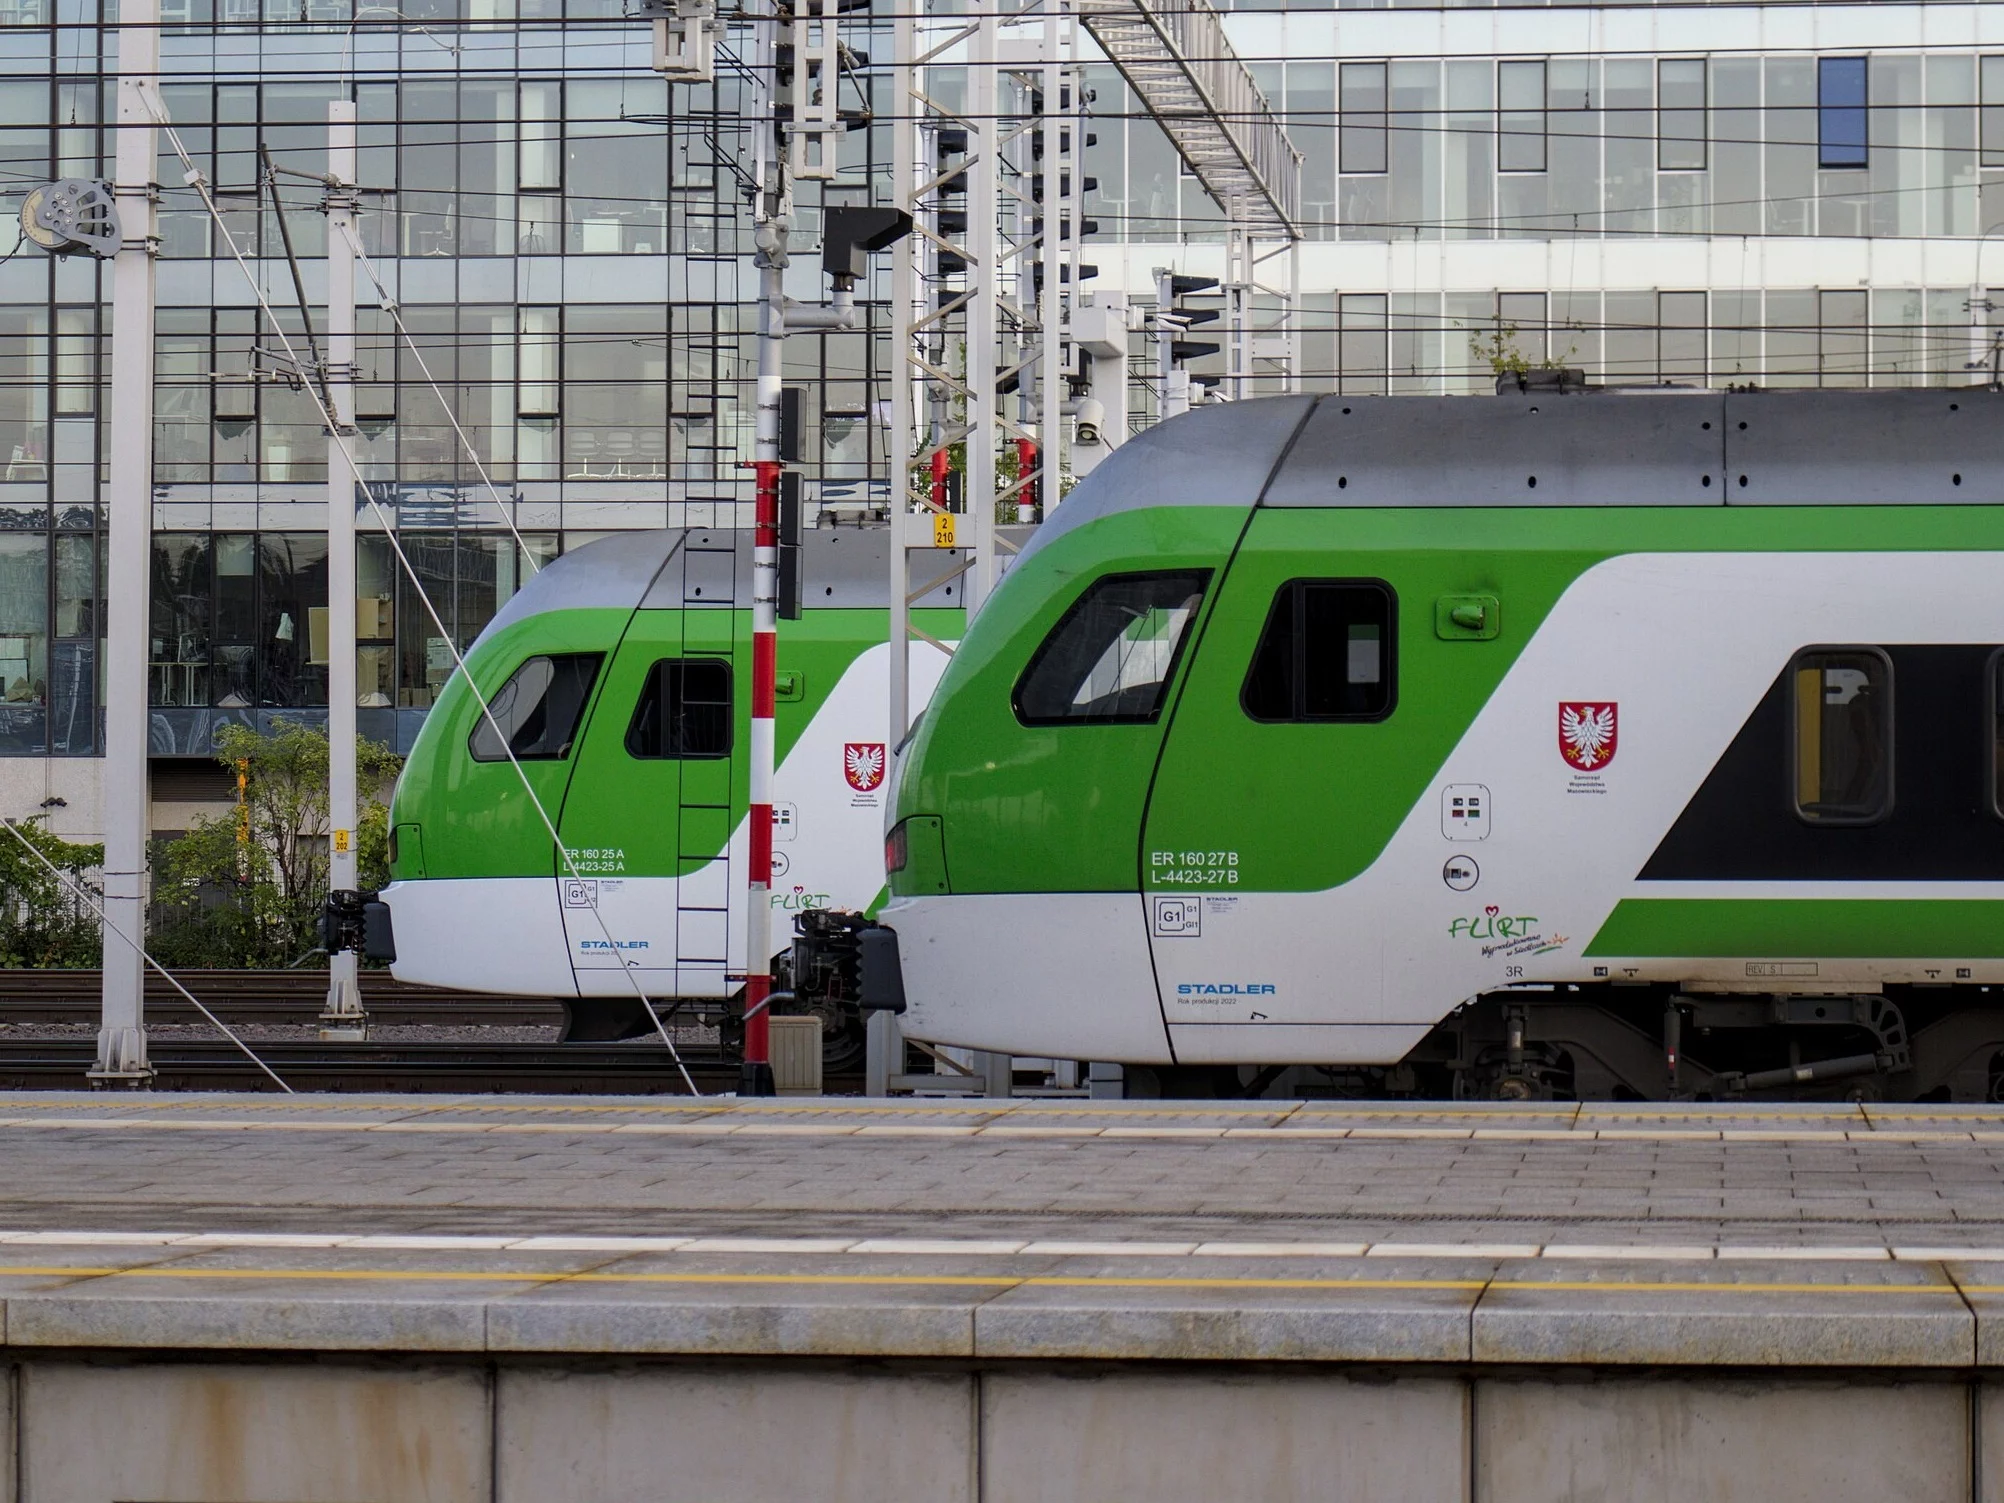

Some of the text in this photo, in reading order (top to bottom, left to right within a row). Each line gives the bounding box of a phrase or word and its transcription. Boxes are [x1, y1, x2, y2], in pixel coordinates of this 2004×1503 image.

[941, 517, 948, 529] 2
[937, 532, 953, 543] 210
[336, 842, 348, 850] 202
[581, 849, 600, 859] 160
[601, 849, 615, 859] 25
[616, 849, 625, 859] A
[1152, 852, 1239, 866] ER 160 27 B
[563, 861, 625, 872] L4423-25 A
[1152, 869, 1239, 884] L-4423-27 B
[571, 890, 584, 898] G1
[770, 893, 831, 910] FLIRT
[1163, 911, 1181, 922] G1
[1448, 916, 1538, 938] FLIRT
[581, 941, 649, 949] STADLER
[1505, 965, 1523, 978] 3R
[1748, 965, 1776, 974] REV S
[1177, 984, 1276, 995] STADLER
